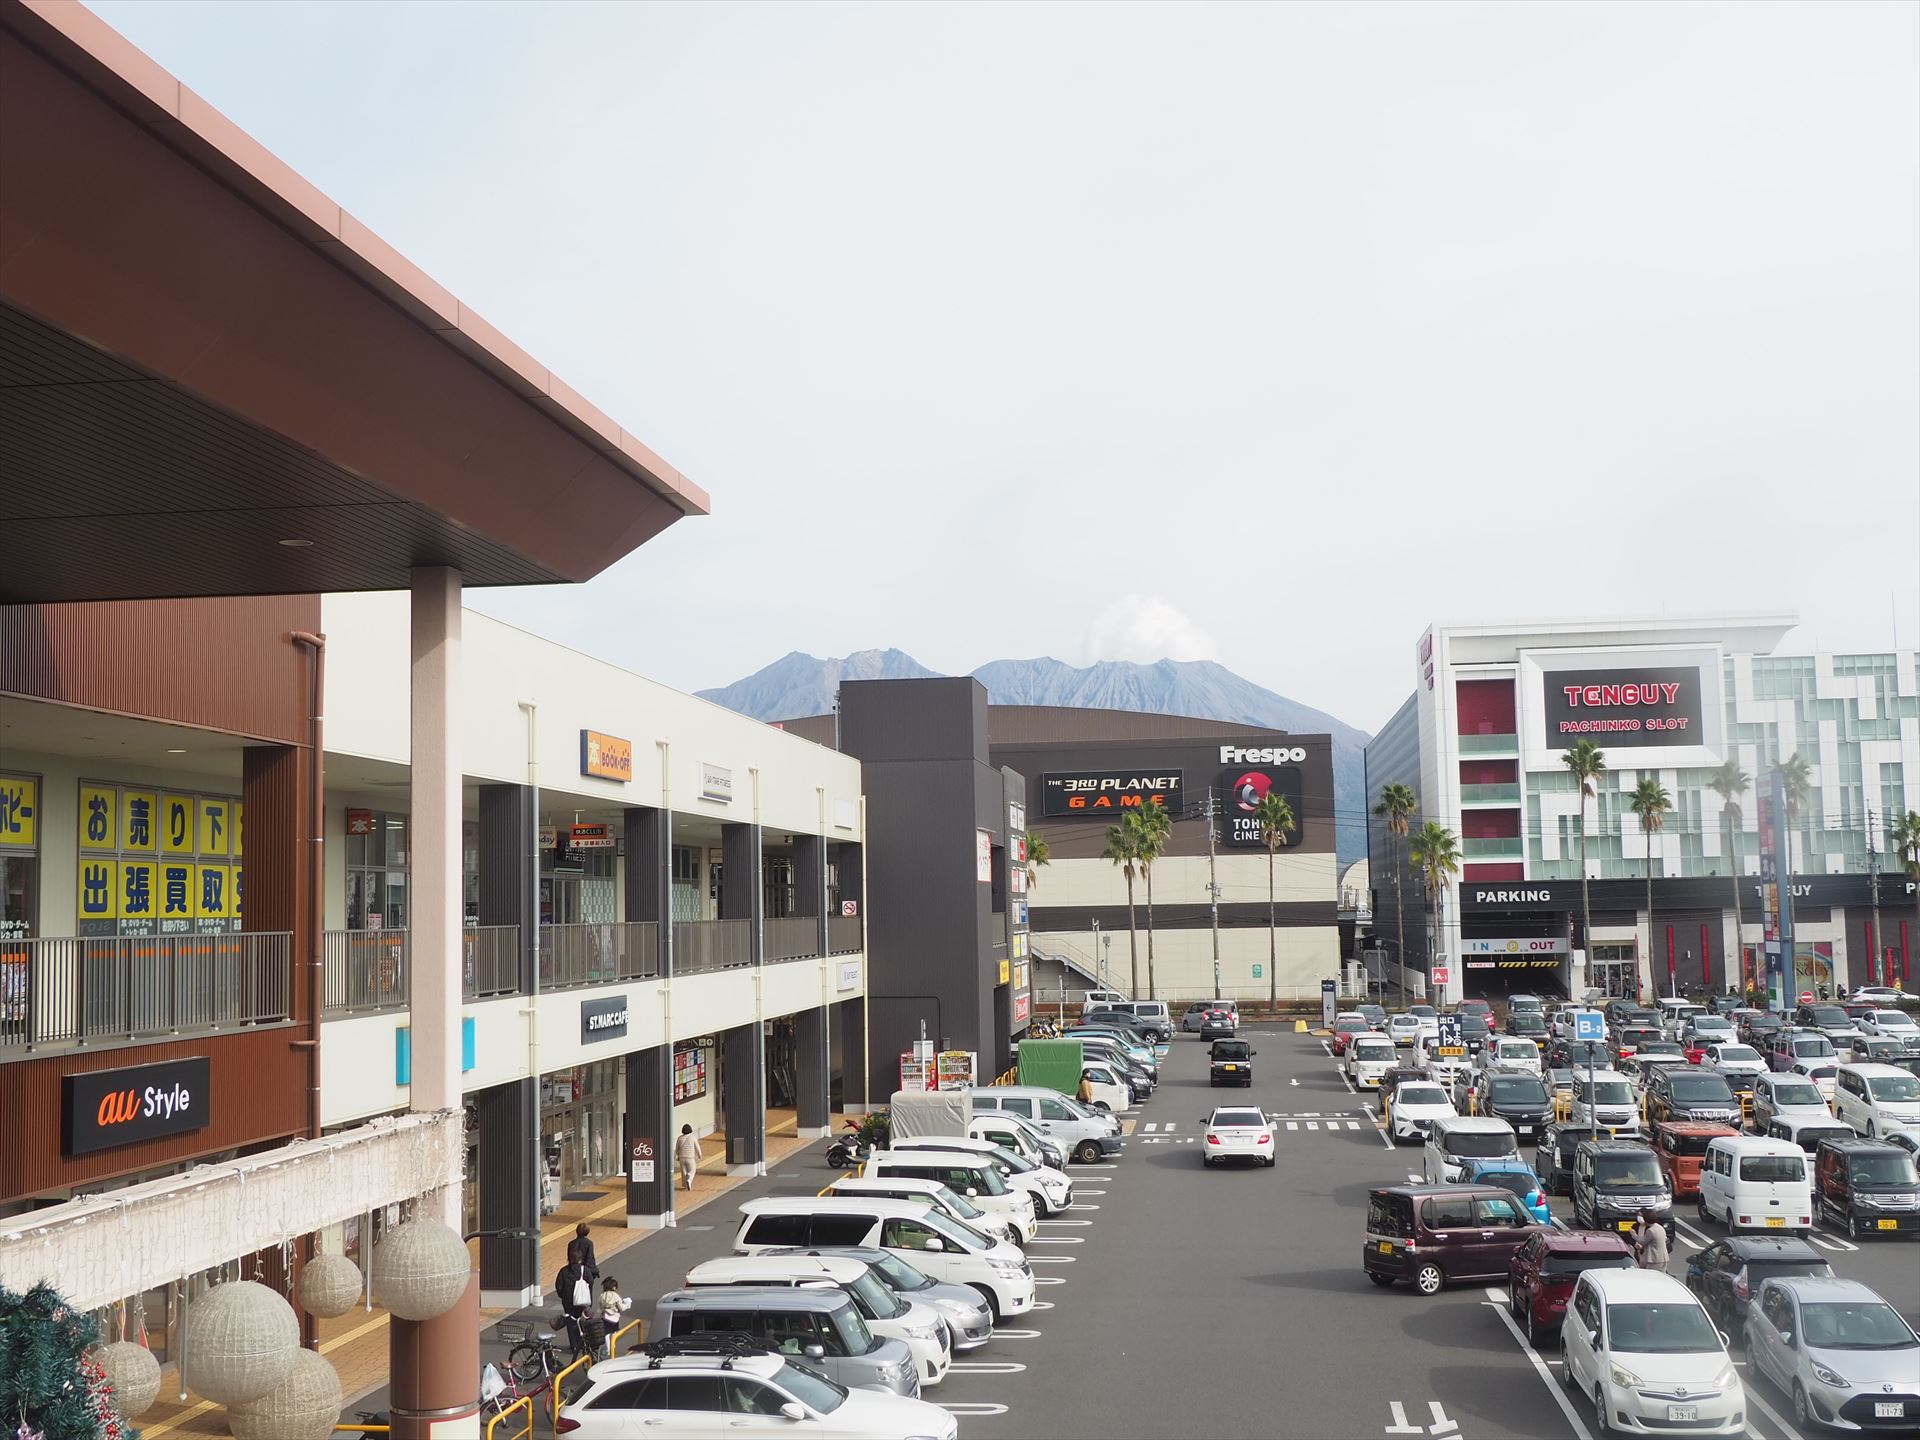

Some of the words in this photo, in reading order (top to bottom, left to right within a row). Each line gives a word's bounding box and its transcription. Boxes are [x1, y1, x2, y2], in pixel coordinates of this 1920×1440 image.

[1563, 683, 1680, 707] TENGUY
[1560, 719, 1641, 732] PACHINKO
[1645, 718, 1688, 730] SLOT
[589, 740, 600, 766] 本
[1220, 746, 1306, 765] Frespo
[1064, 779, 1098, 791] 3RD
[1069, 795, 1165, 808] GAME
[88, 794, 242, 850] お売り下
[352, 819, 368, 833] 本
[1233, 818, 1264, 830] TOH
[540, 834, 555, 845] day
[84, 864, 242, 914] 出張買取
[1755, 884, 1812, 897] TUY
[1906, 882, 1920, 894] P
[1476, 890, 1551, 903] PARKING
[1472, 942, 1489, 951] IN
[1529, 941, 1556, 951] OUT
[1434, 972, 1448, 981] A-1
[1439, 1016, 1455, 1024] 出口
[1580, 1020, 1602, 1034] B-2
[97, 1088, 141, 1127] au
[143, 1082, 190, 1120] Style
